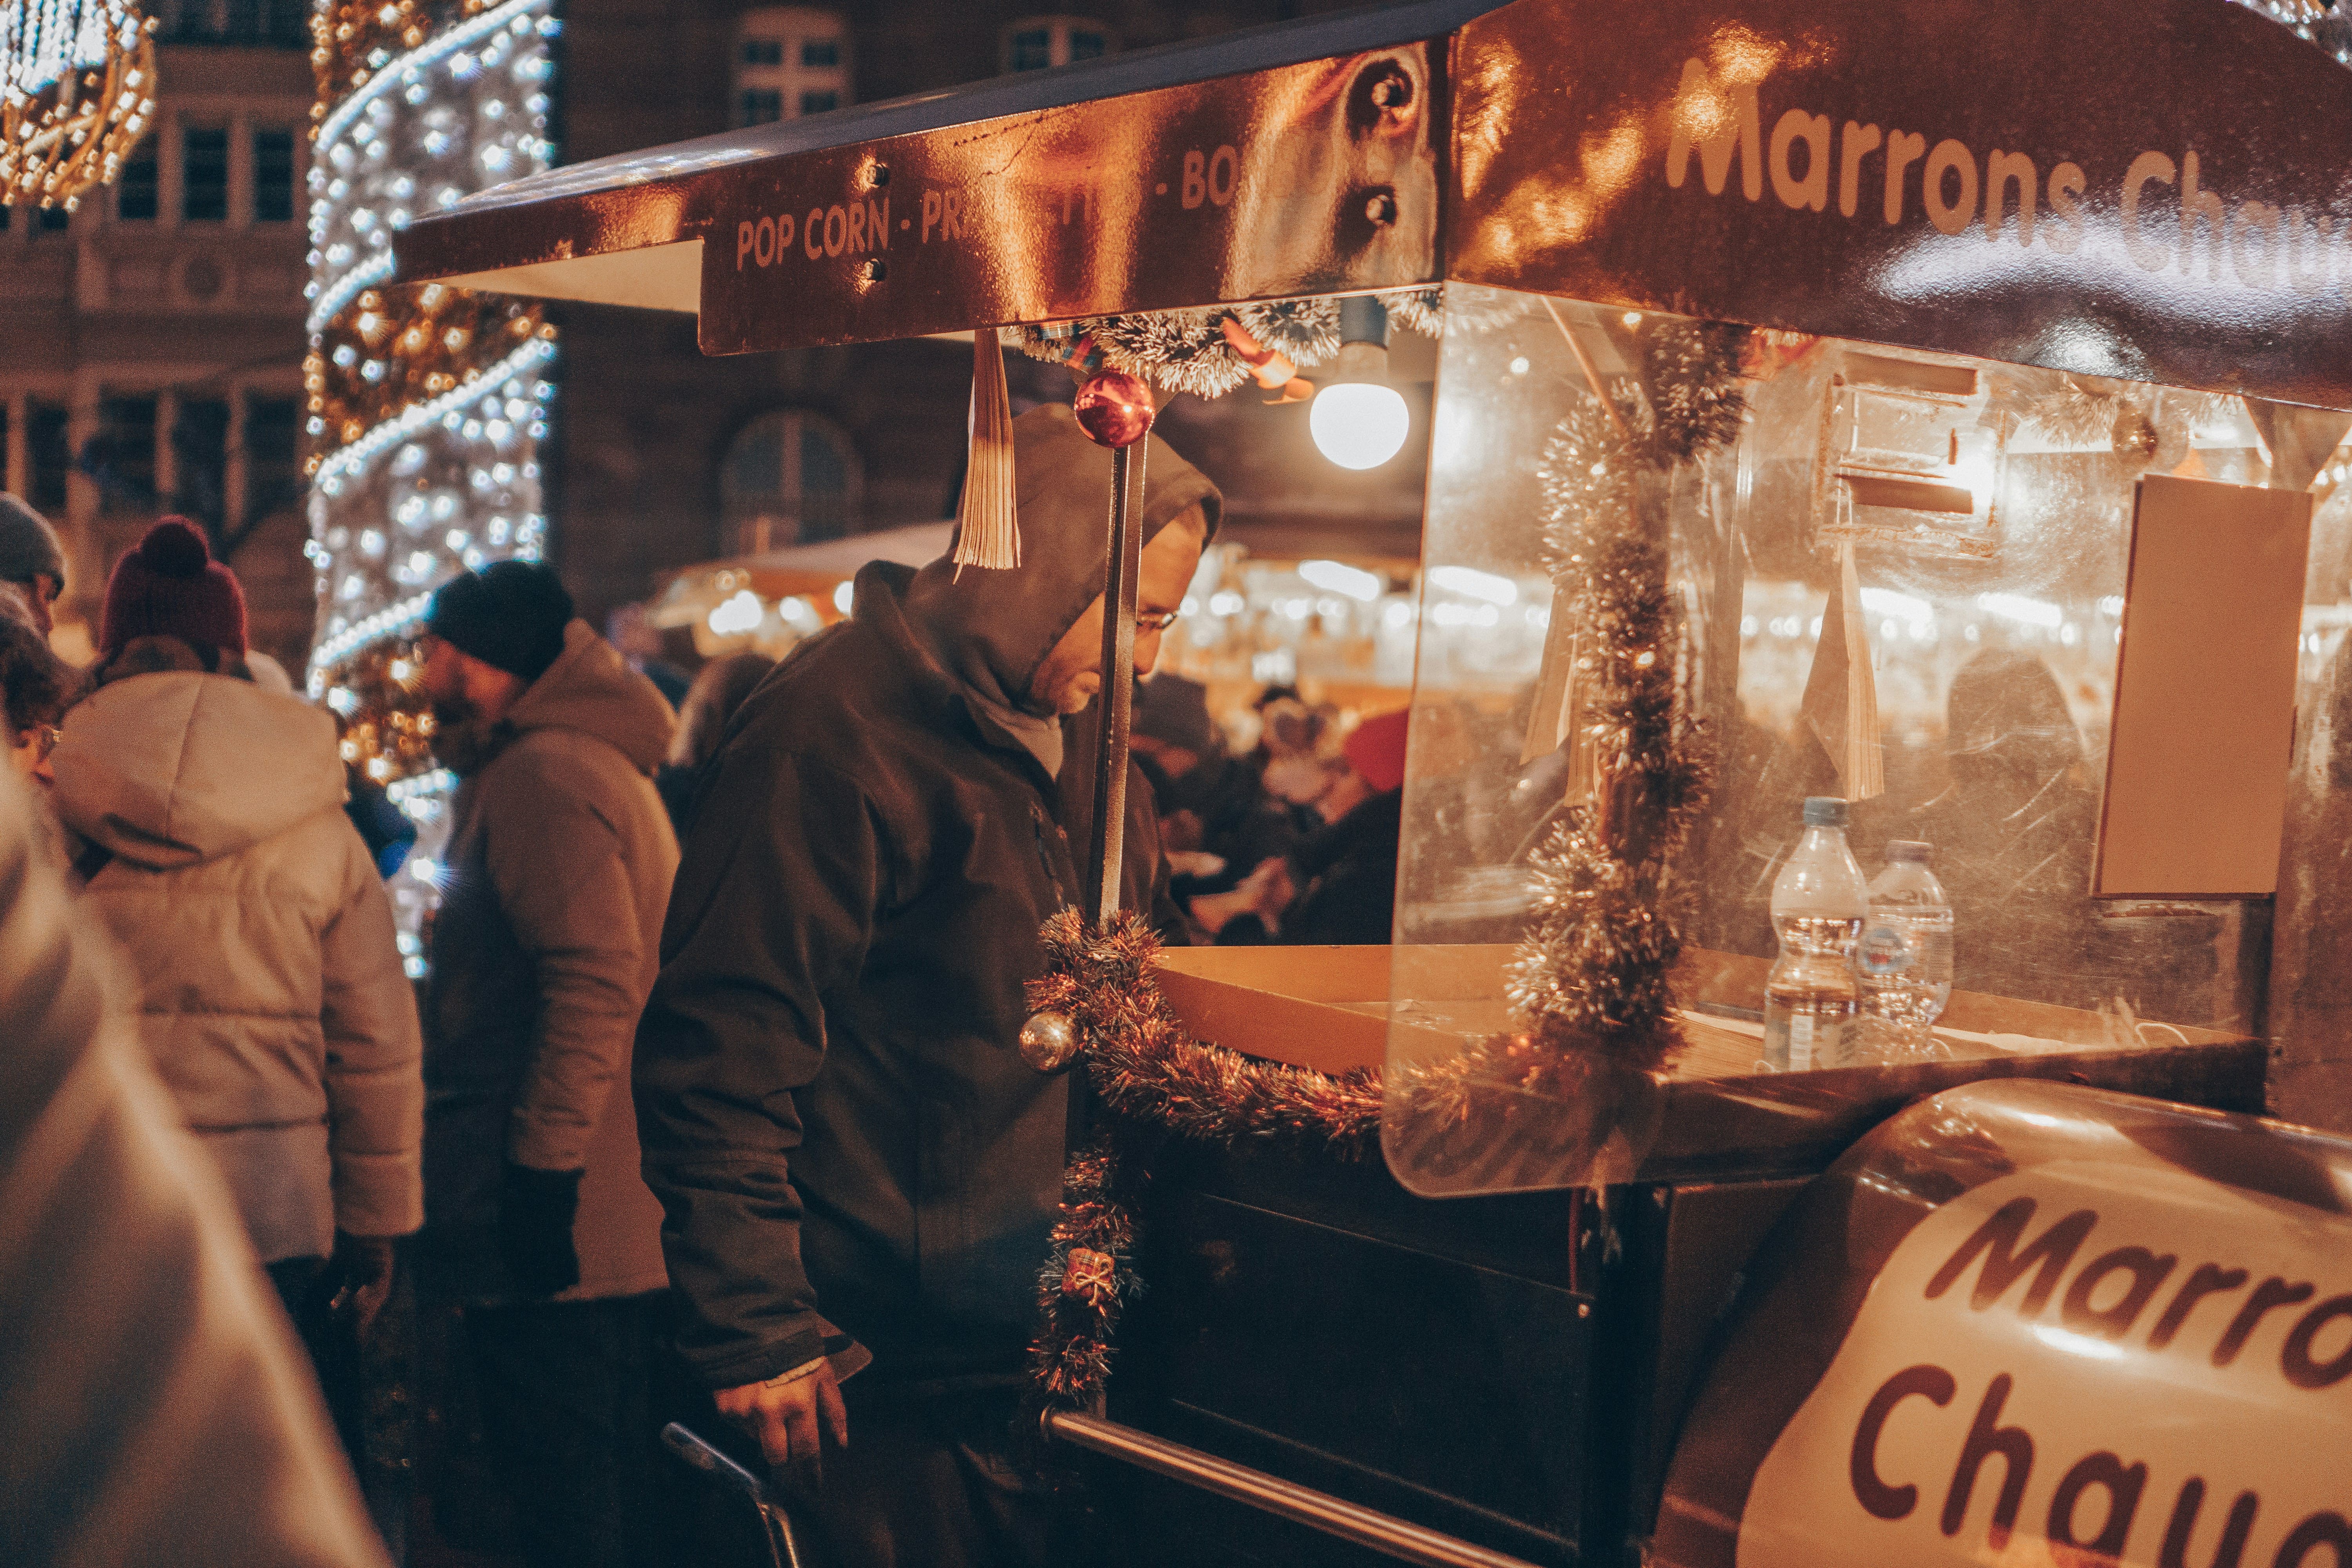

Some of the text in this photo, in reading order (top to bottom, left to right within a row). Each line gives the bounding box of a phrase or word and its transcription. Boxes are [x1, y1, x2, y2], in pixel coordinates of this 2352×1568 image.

[737, 213, 795, 272] POP
[804, 196, 890, 260] CORN
[1666, 56, 2352, 299] Marrons Chau
